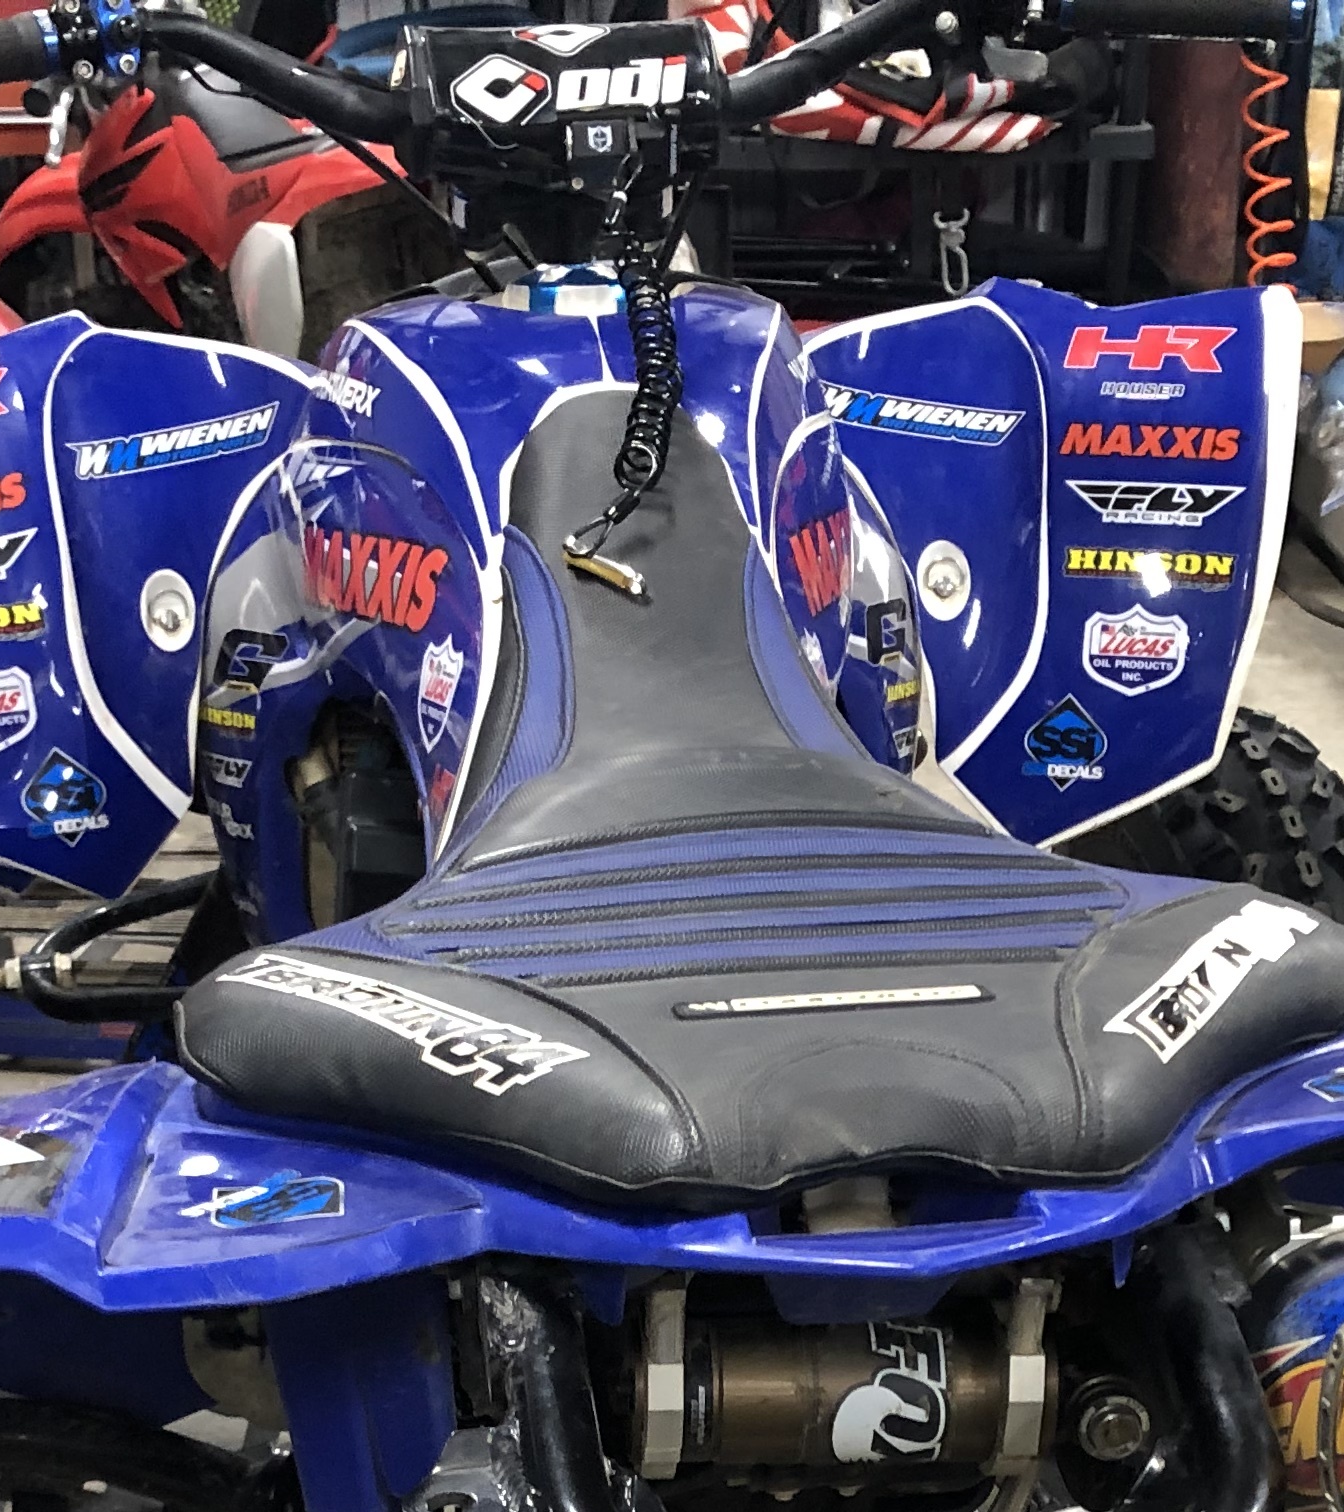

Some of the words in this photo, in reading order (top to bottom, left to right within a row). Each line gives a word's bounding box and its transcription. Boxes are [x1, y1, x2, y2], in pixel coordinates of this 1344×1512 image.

[1064, 325, 1238, 373] HR
[1100, 382, 1185, 397] HOUSER
[879, 399, 1017, 432] WIENEN
[140, 408, 274, 457] WIENEN
[1059, 422, 1241, 461] MAXXIS
[1109, 485, 1238, 514] FLY
[1098, 636, 1175, 657] LUCAS
[1093, 658, 1112, 668] OIL
[1114, 659, 1174, 671] PRODUCTS
[1121, 672, 1144, 682] INC.
